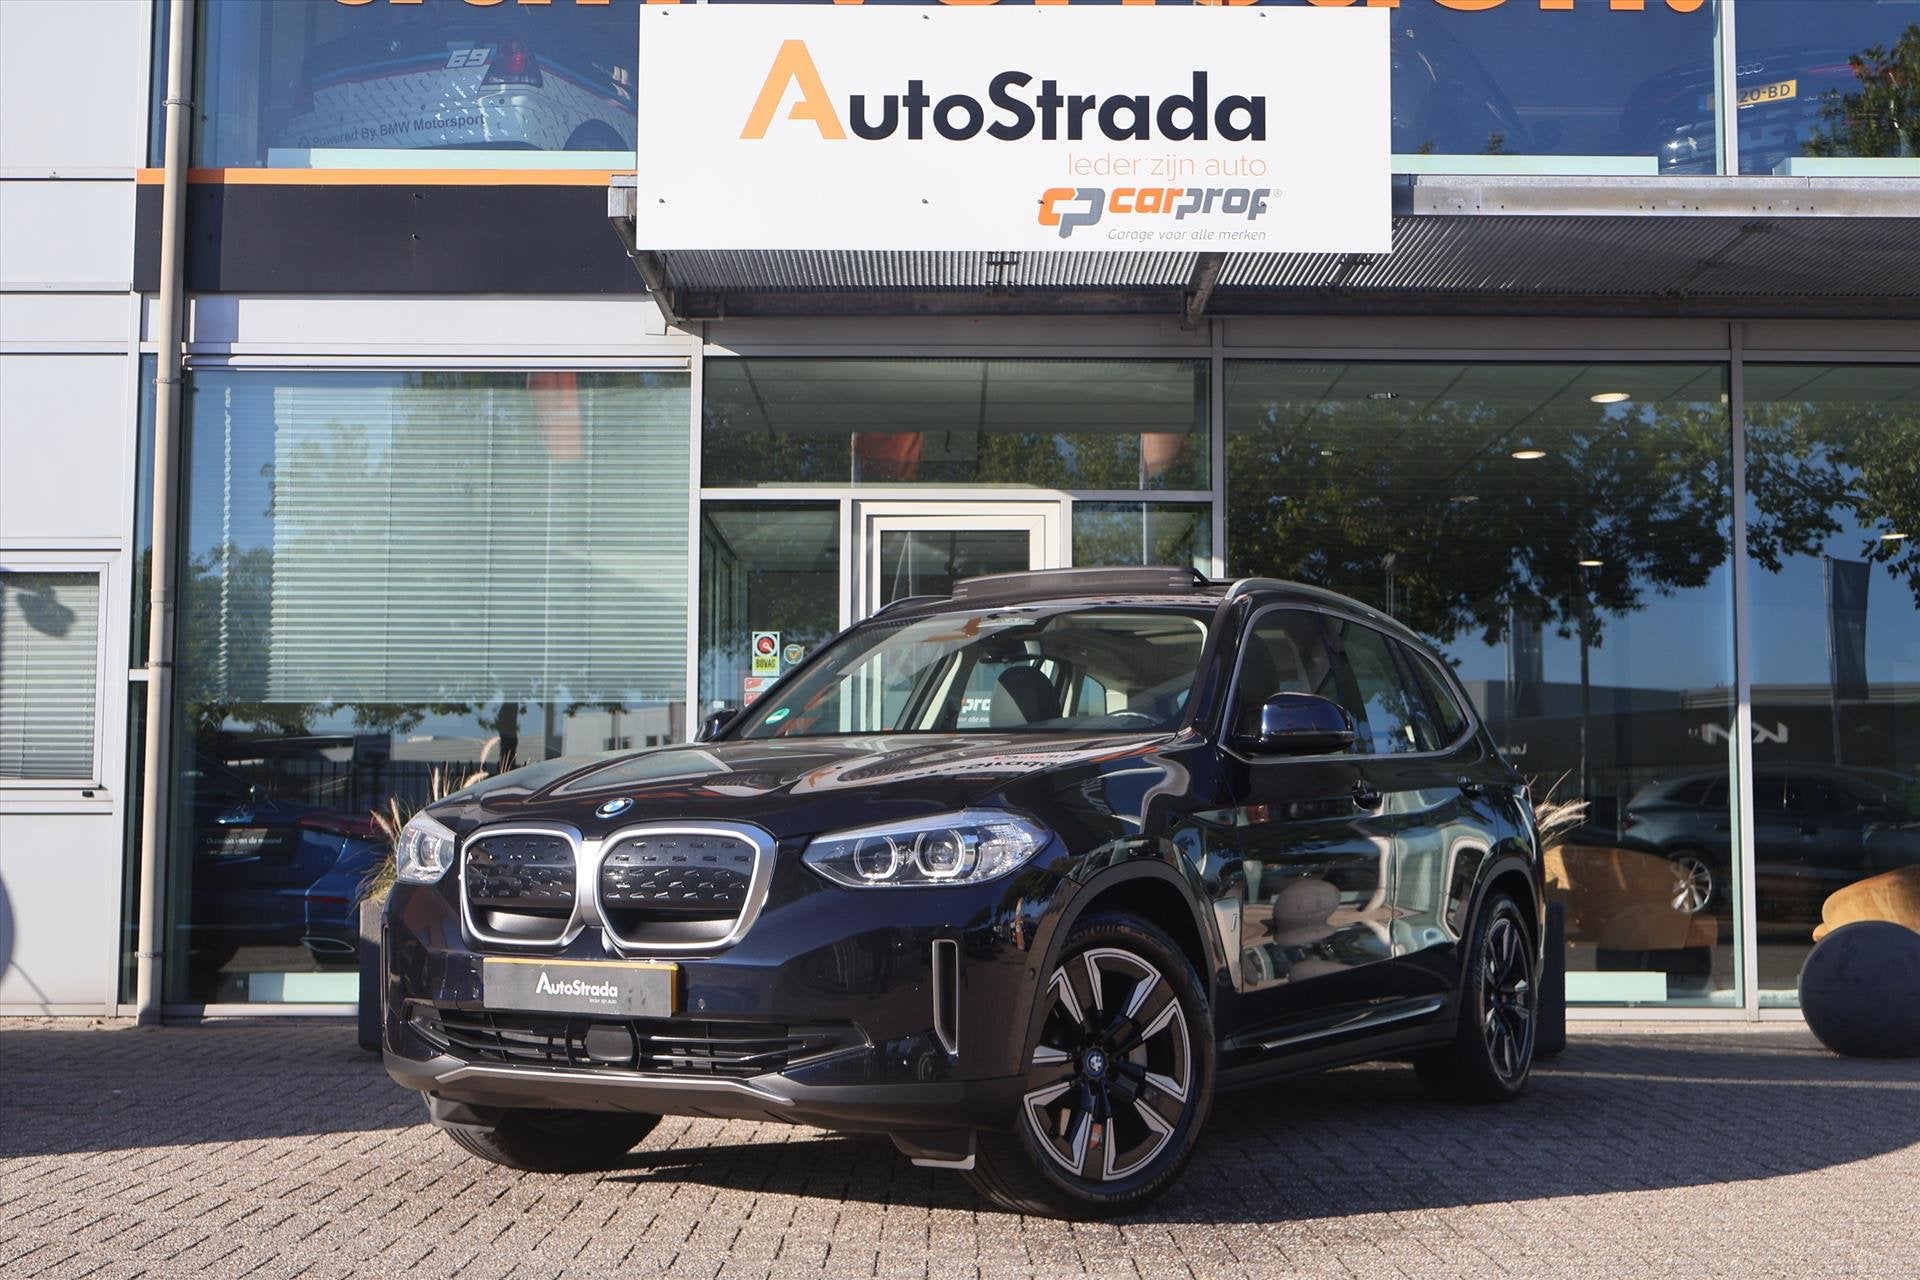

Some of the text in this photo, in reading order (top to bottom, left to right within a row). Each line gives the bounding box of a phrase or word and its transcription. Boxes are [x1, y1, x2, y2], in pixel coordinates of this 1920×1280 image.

[446, 48, 490, 68] 69
[739, 39, 1267, 142] AutoStrada
[1739, 84, 1791, 103] 20-BD
[312, 114, 485, 146] Powered By BMW Motorsport
[1068, 153, 1268, 182] Ieder zijn auto
[1108, 188, 1271, 221] carprof
[1108, 228, 1267, 243] Garage voor alle merken
[535, 971, 618, 998] AutoStrada
